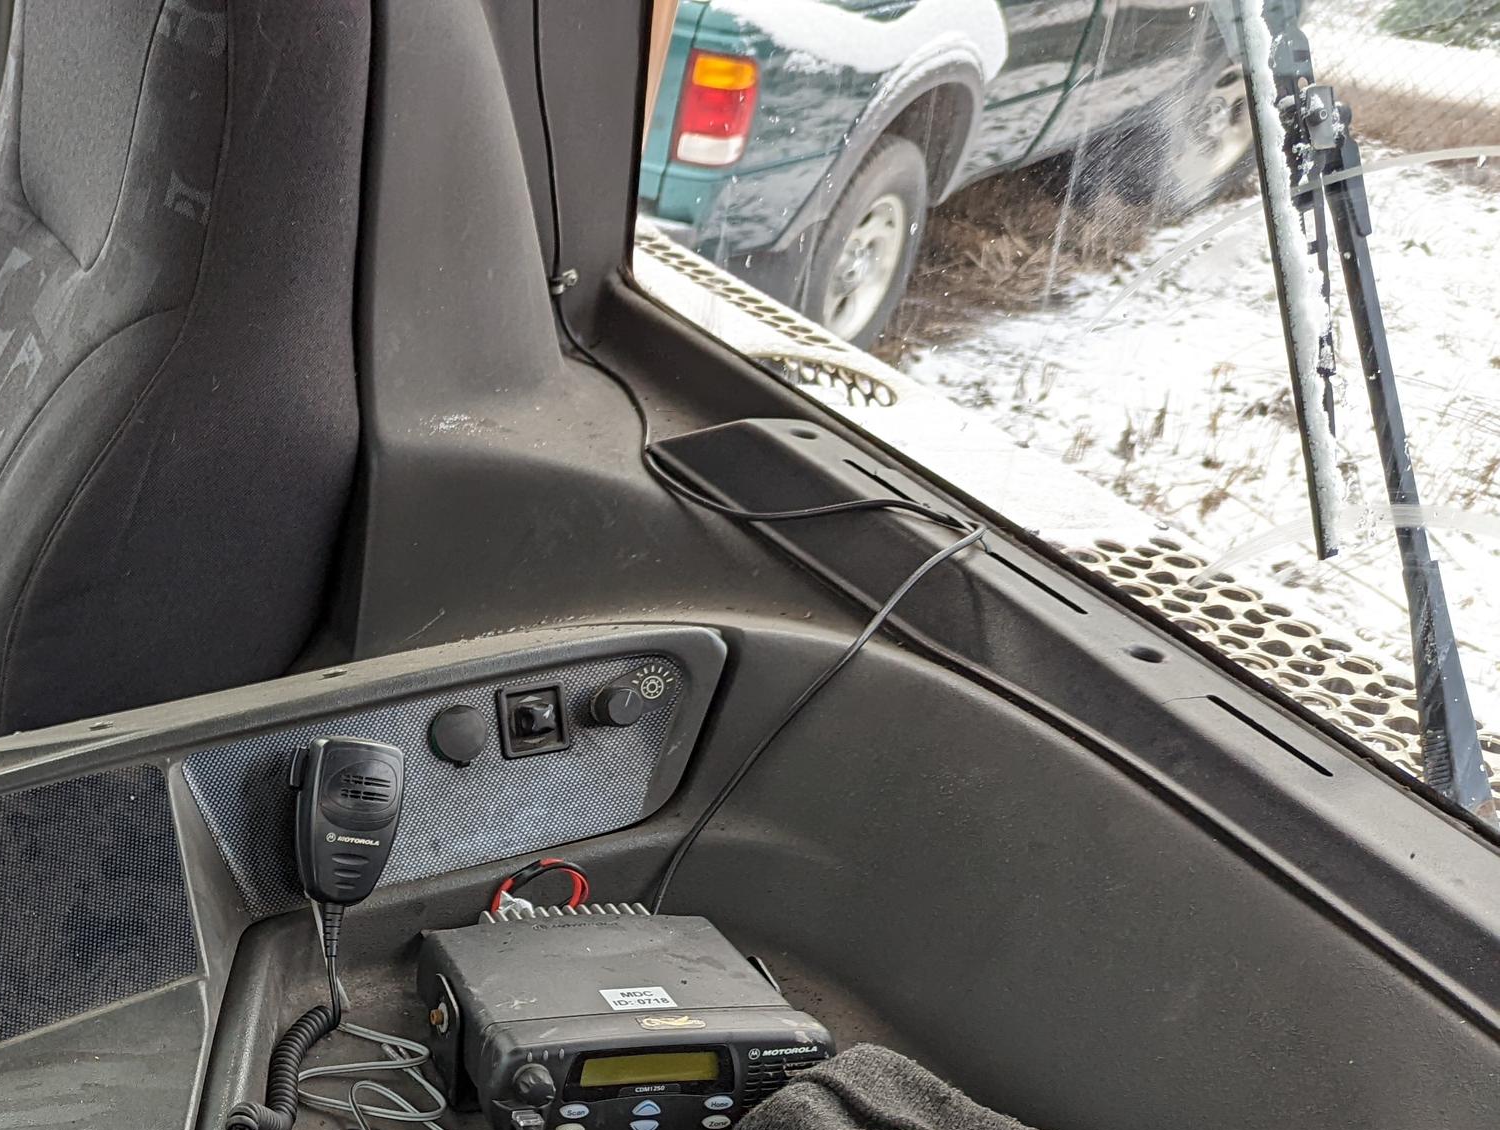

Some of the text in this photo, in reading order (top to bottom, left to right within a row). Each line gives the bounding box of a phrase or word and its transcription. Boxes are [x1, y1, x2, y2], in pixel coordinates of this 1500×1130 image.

[337, 836, 380, 846] MOTOROLA
[620, 990, 654, 998] MDC
[612, 997, 670, 1007] ID: 0718
[762, 1045, 818, 1057] MOTOROLA
[634, 1085, 665, 1093] CDM1250
[567, 1109, 586, 1117] Scan
